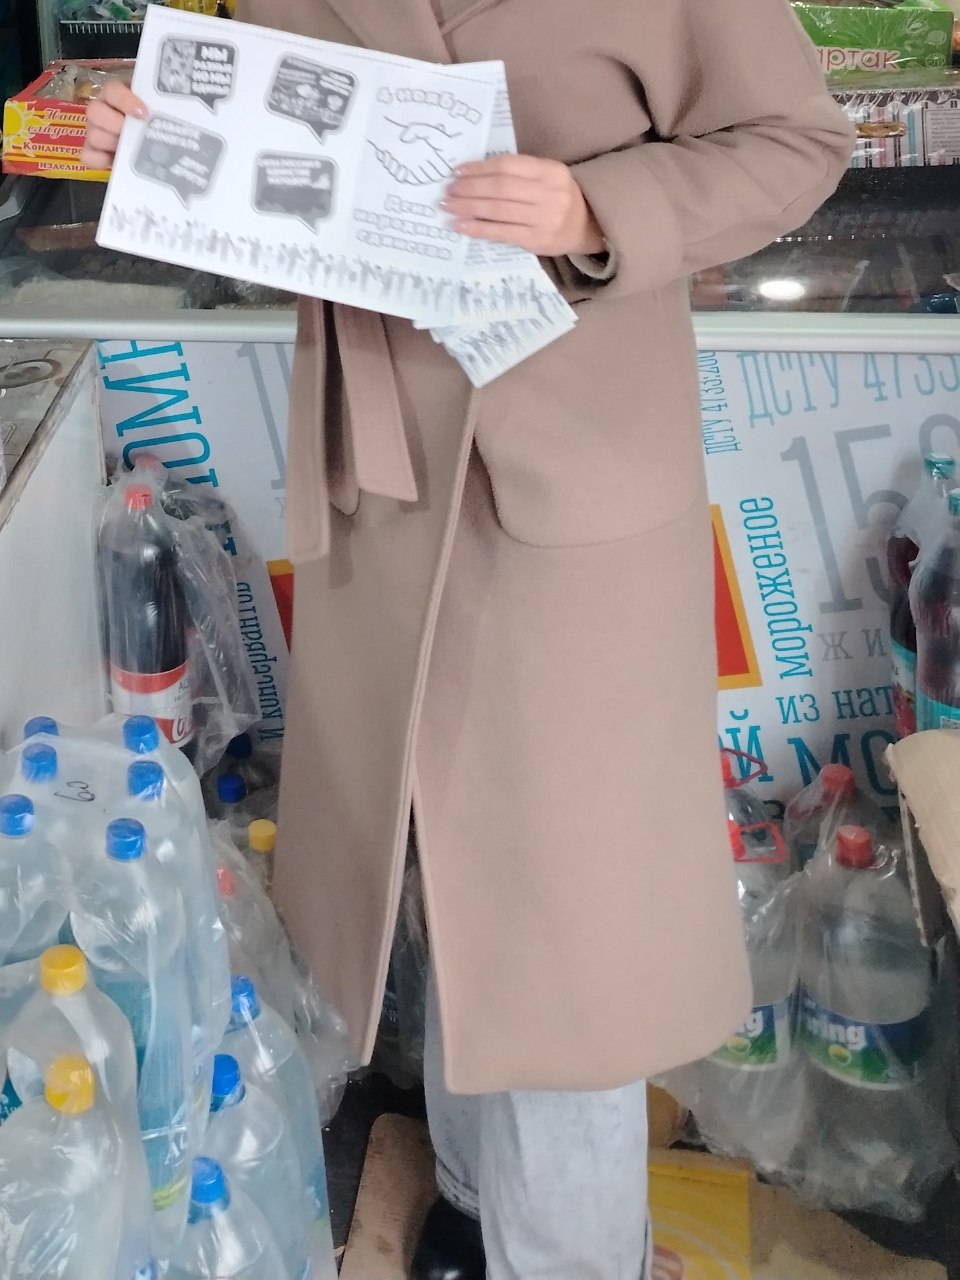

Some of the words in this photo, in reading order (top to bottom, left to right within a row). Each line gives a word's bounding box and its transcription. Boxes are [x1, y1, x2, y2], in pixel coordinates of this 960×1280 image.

[395, 87, 484, 125] ноября
[39, 161, 86, 172] изделия
[736, 351, 840, 429] ДСТУ
[702, 419, 743, 456] ДСТУ
[739, 495, 814, 680] мороженое
[776, 693, 821, 725] из
[831, 685, 896, 721] нат
[718, 708, 774, 783] Й
